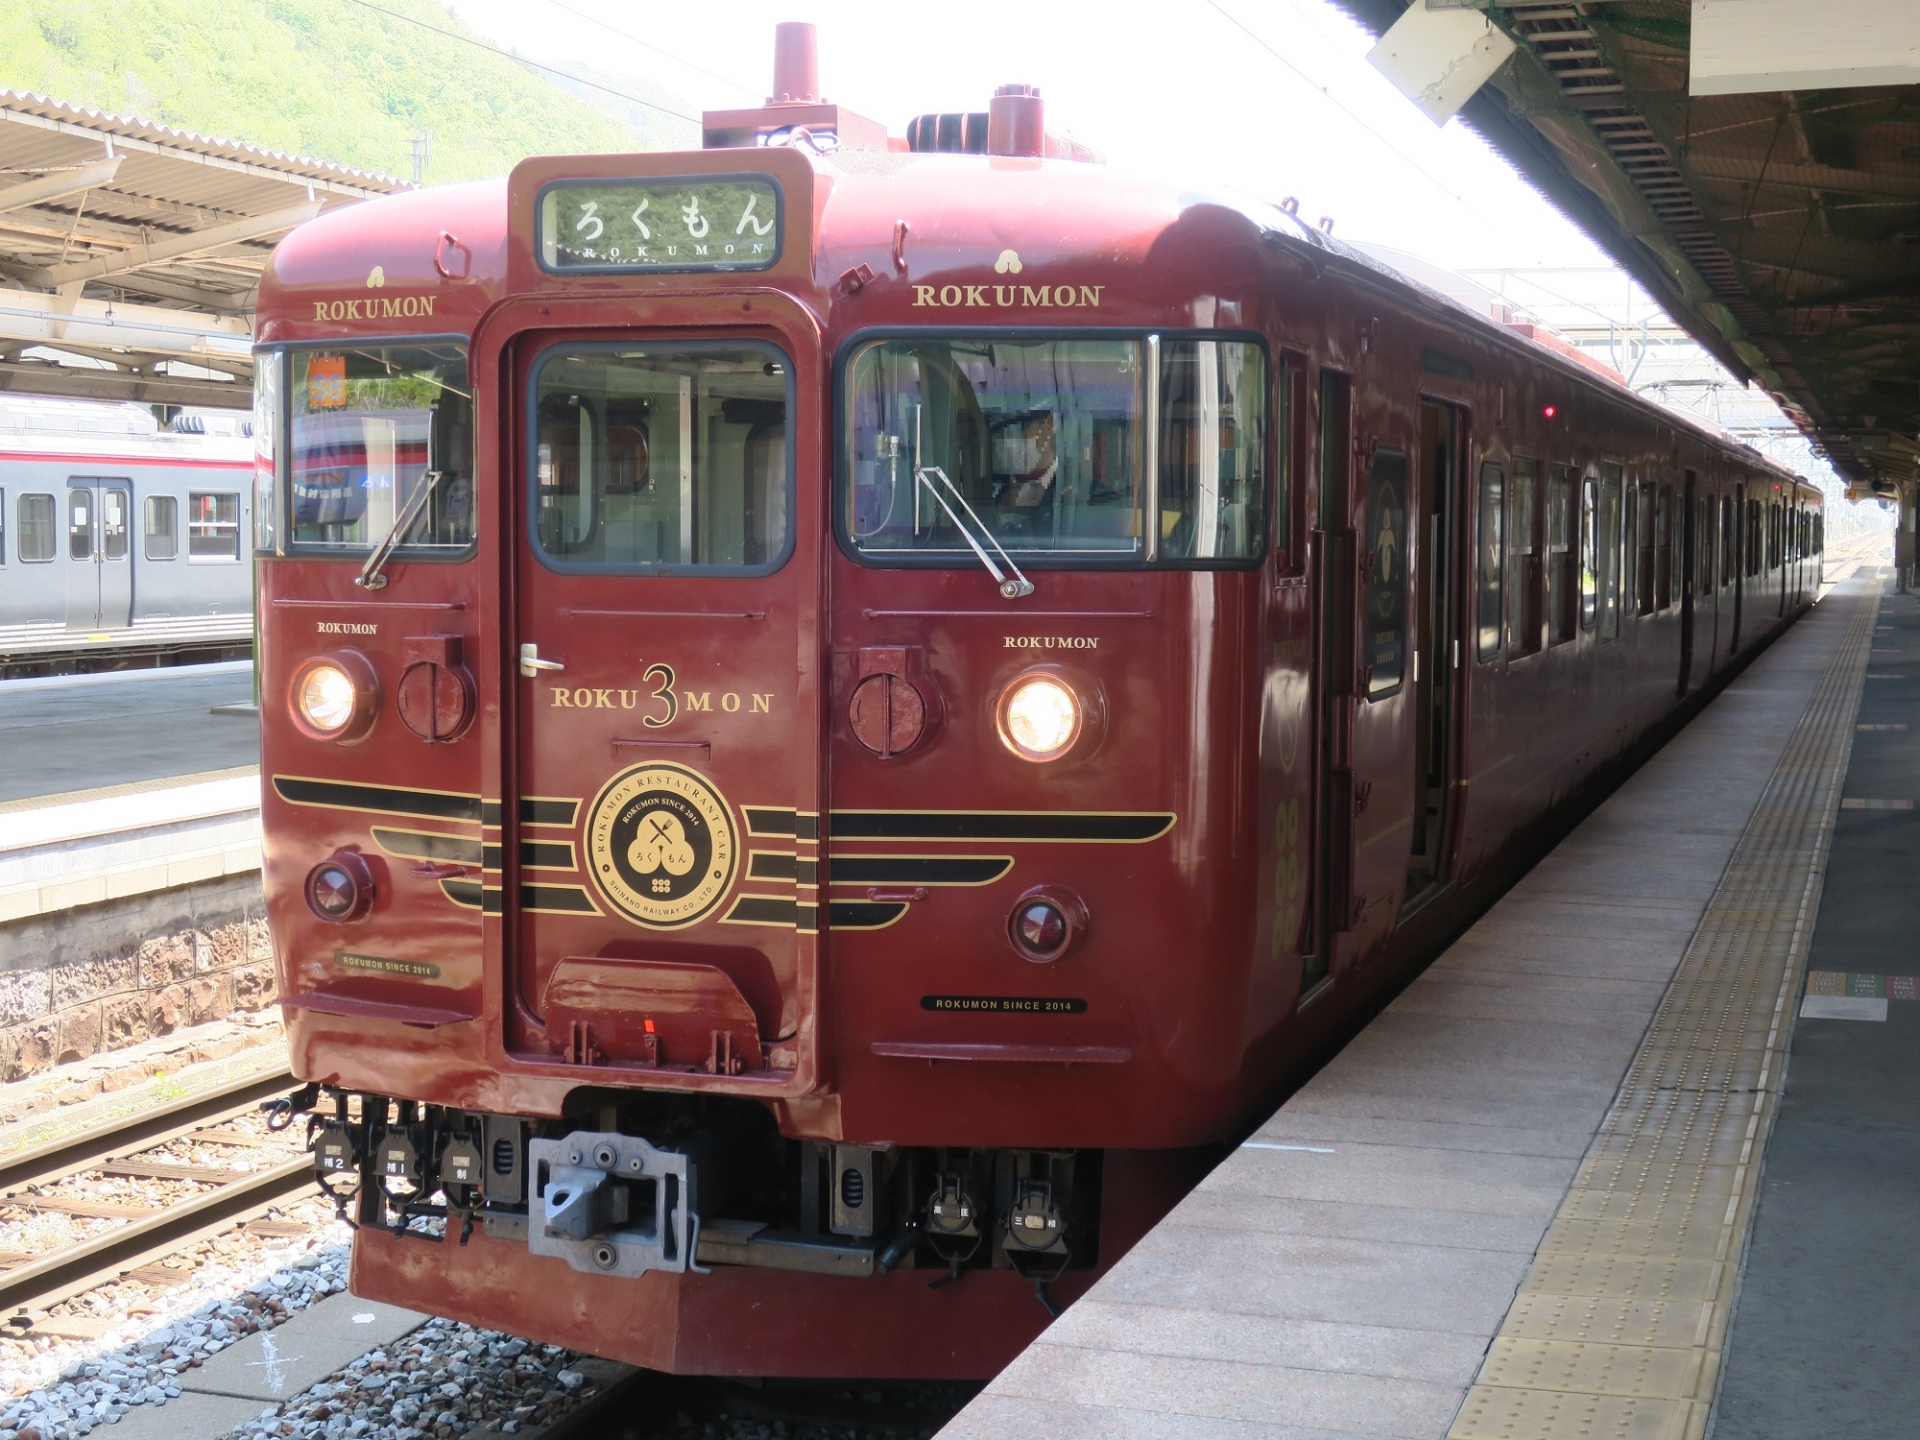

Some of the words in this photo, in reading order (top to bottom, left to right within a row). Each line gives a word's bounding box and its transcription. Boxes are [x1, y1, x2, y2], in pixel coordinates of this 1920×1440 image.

[576, 194, 774, 241] ろくもん
[583, 243, 764, 258] ROKUMON
[911, 285, 1106, 307] ROKUMON
[313, 295, 437, 322] ROKUMON
[317, 622, 378, 635] ROKUMON
[1002, 636, 1100, 649] ROKUMON
[550, 687, 638, 710] ROKU
[642, 662, 679, 729] 3
[683, 691, 775, 713] MON
[597, 785, 632, 853] ROKUMON
[636, 775, 721, 823] RESTAURANT
[716, 829, 727, 861] CAR
[621, 796, 661, 824] ROKUMON
[660, 797, 686, 813] SINCE
[684, 808, 700, 827] 2014
[609, 879, 641, 910] SHINANO
[642, 906, 681, 916] RAILWAY
[343, 956, 383, 969] ROKUMON
[385, 963, 410, 973] SINCE
[412, 967, 431, 976] 2014
[936, 999, 998, 1010] ROKUMON
[1002, 1001, 1040, 1011] SINCE
[1045, 1002, 1072, 1011] 2014
